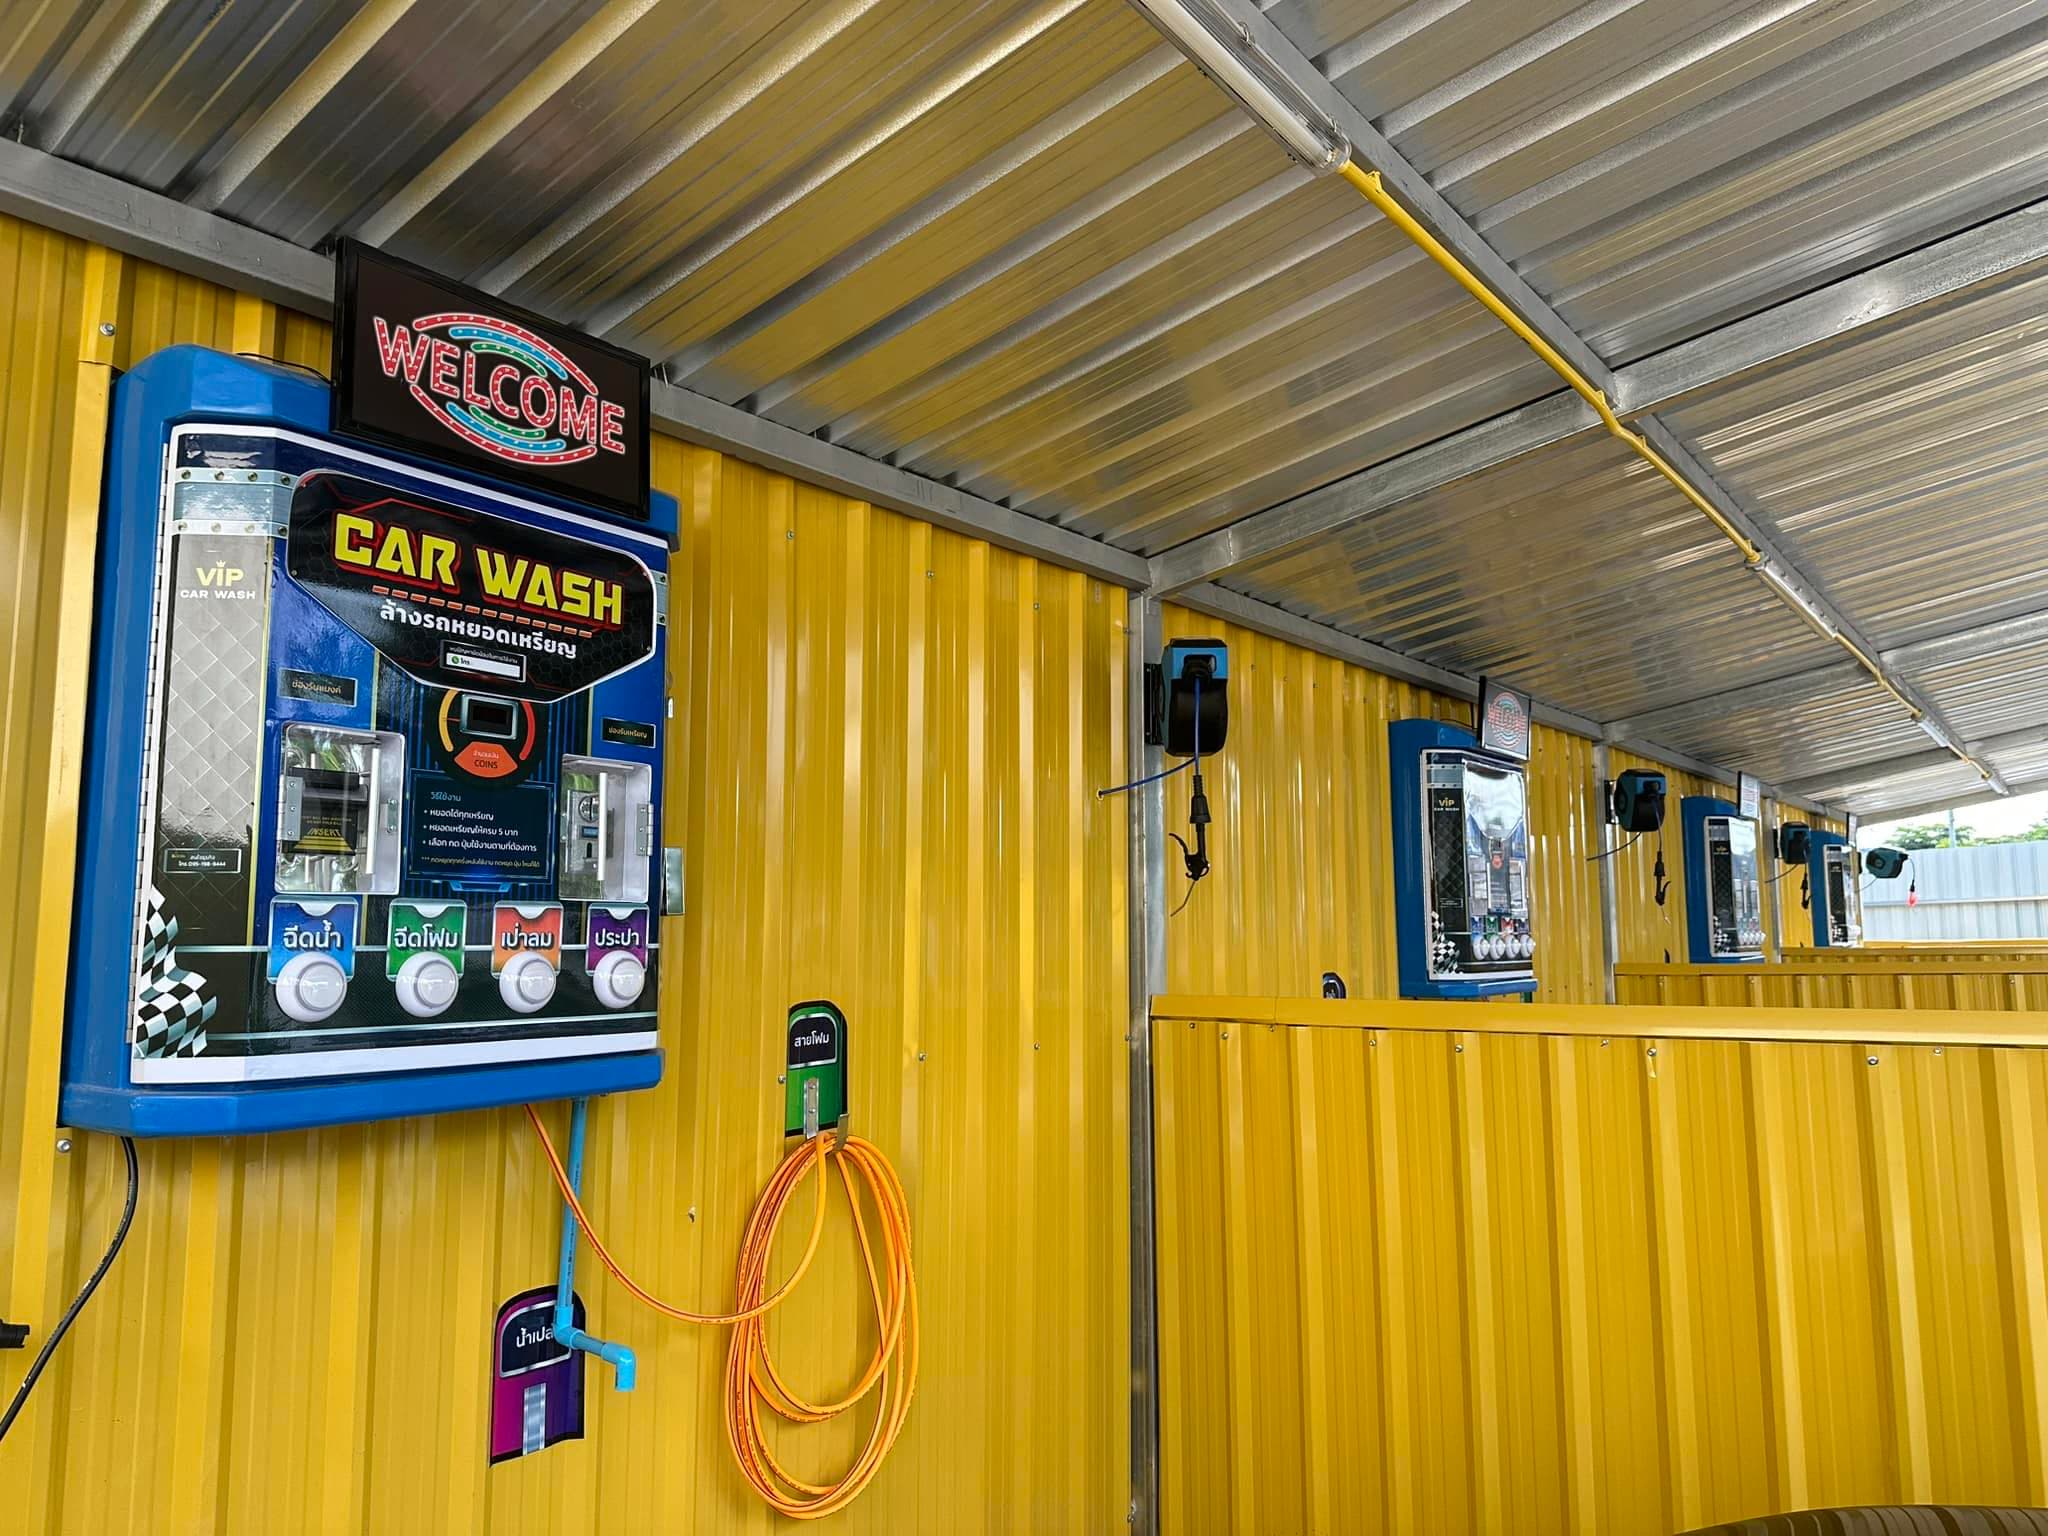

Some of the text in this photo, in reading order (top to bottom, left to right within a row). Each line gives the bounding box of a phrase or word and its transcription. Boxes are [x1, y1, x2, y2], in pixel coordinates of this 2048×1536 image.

[372, 316, 626, 454] WELCOME
[196, 566, 245, 587] VIP
[335, 512, 624, 626] CAR WASH
[180, 590, 256, 600] CAR WASH
[379, 599, 577, 659] ล้างรถหยอดเหรียญ
[474, 760, 498, 769] COINS
[307, 827, 342, 837] INSERT
[283, 920, 342, 948] ฉีดน้ำ
[394, 924, 458, 948] ฉีดโฟม
[501, 922, 553, 948] เป่าลม
[595, 928, 640, 947] ประปา
[794, 1030, 830, 1047] สายโฟม
[516, 1325, 554, 1348] น้ำเปล
